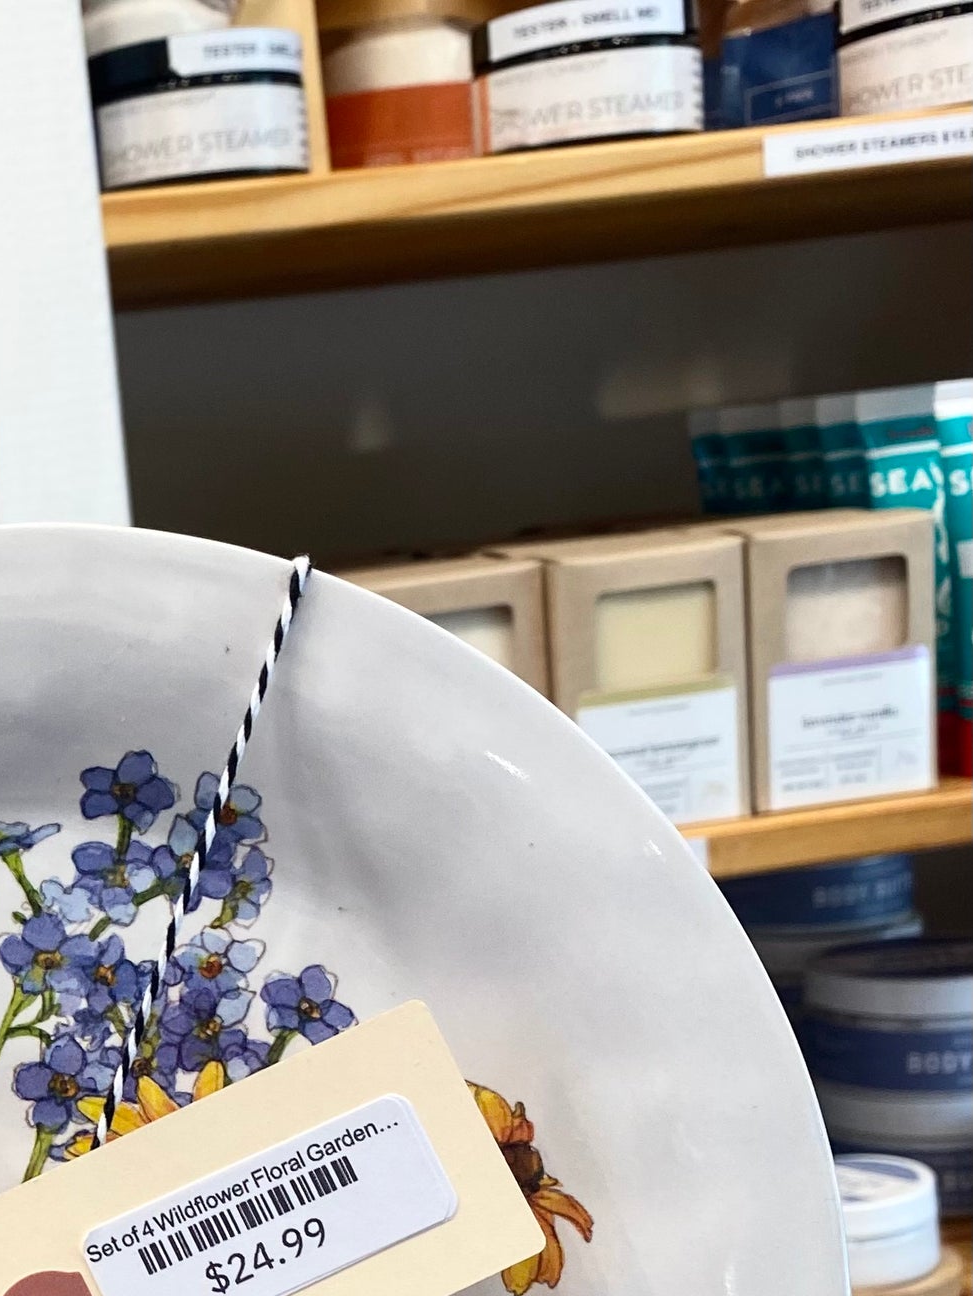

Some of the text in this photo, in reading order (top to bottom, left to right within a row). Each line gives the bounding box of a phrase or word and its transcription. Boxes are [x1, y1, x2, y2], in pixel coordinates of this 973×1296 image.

[203, 43, 257, 60] TESTER
[869, 466, 934, 498] SEA
[86, 1120, 400, 1263] Set of 4 Wildflower Floral Garden...
[205, 1217, 326, 1295] $24.99
